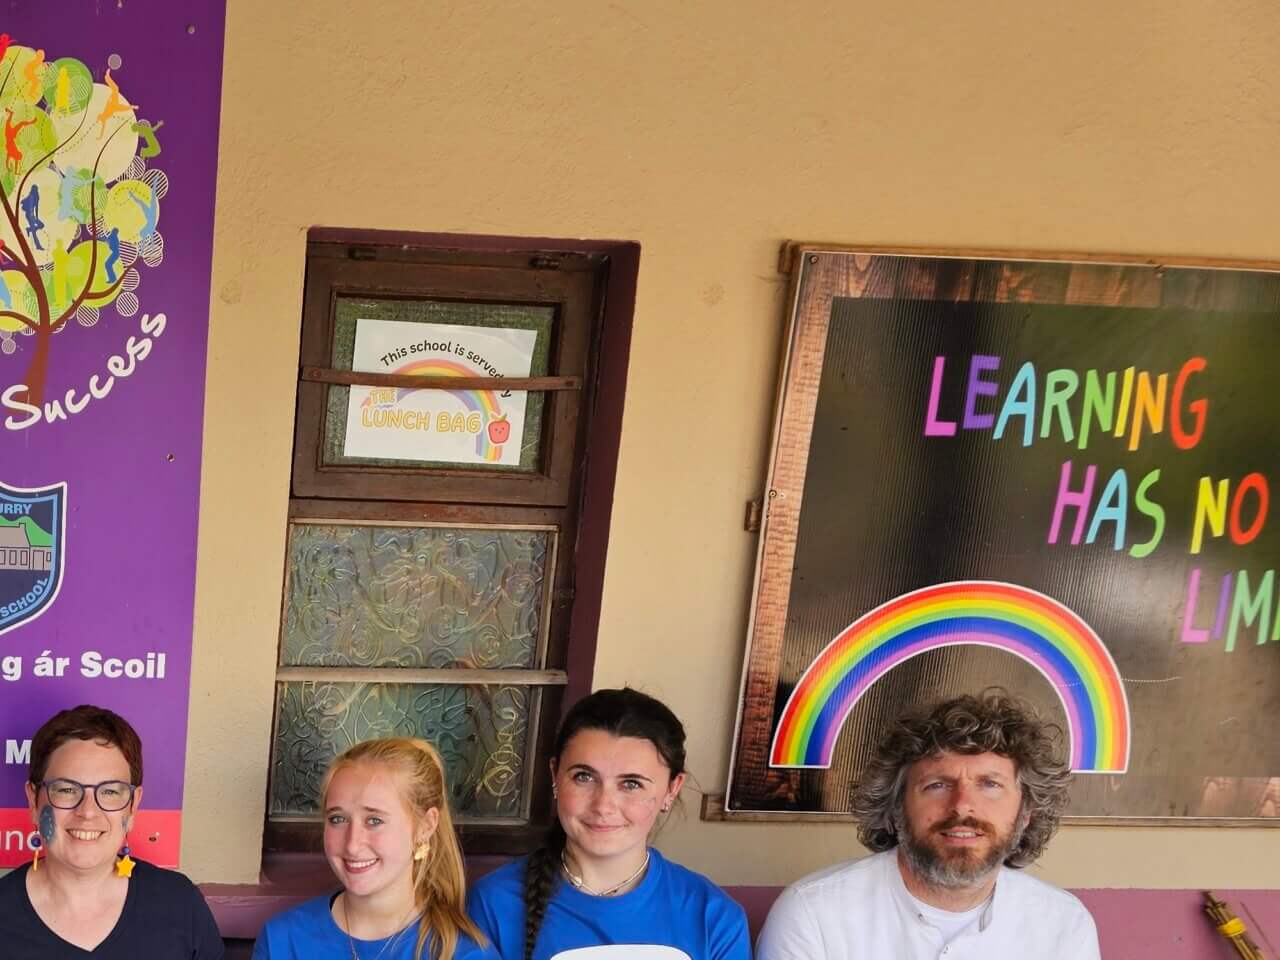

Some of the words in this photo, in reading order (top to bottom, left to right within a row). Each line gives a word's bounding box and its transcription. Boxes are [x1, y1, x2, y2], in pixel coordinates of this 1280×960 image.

[2, 312, 166, 430] Success
[380, 348, 408, 368] This
[410, 340, 452, 354] school
[454, 344, 465, 357] is
[466, 351, 505, 378] serve
[369, 389, 396, 405] THE
[924, 354, 1209, 451] LEARNING
[361, 408, 431, 432] LUNCH
[435, 412, 482, 434] BAG
[1047, 460, 1166, 559] HAS
[1190, 472, 1270, 555] NO
[0, 577, 47, 617] SCHOOL
[32, 650, 70, 678] ár
[79, 651, 167, 680] Scoil
